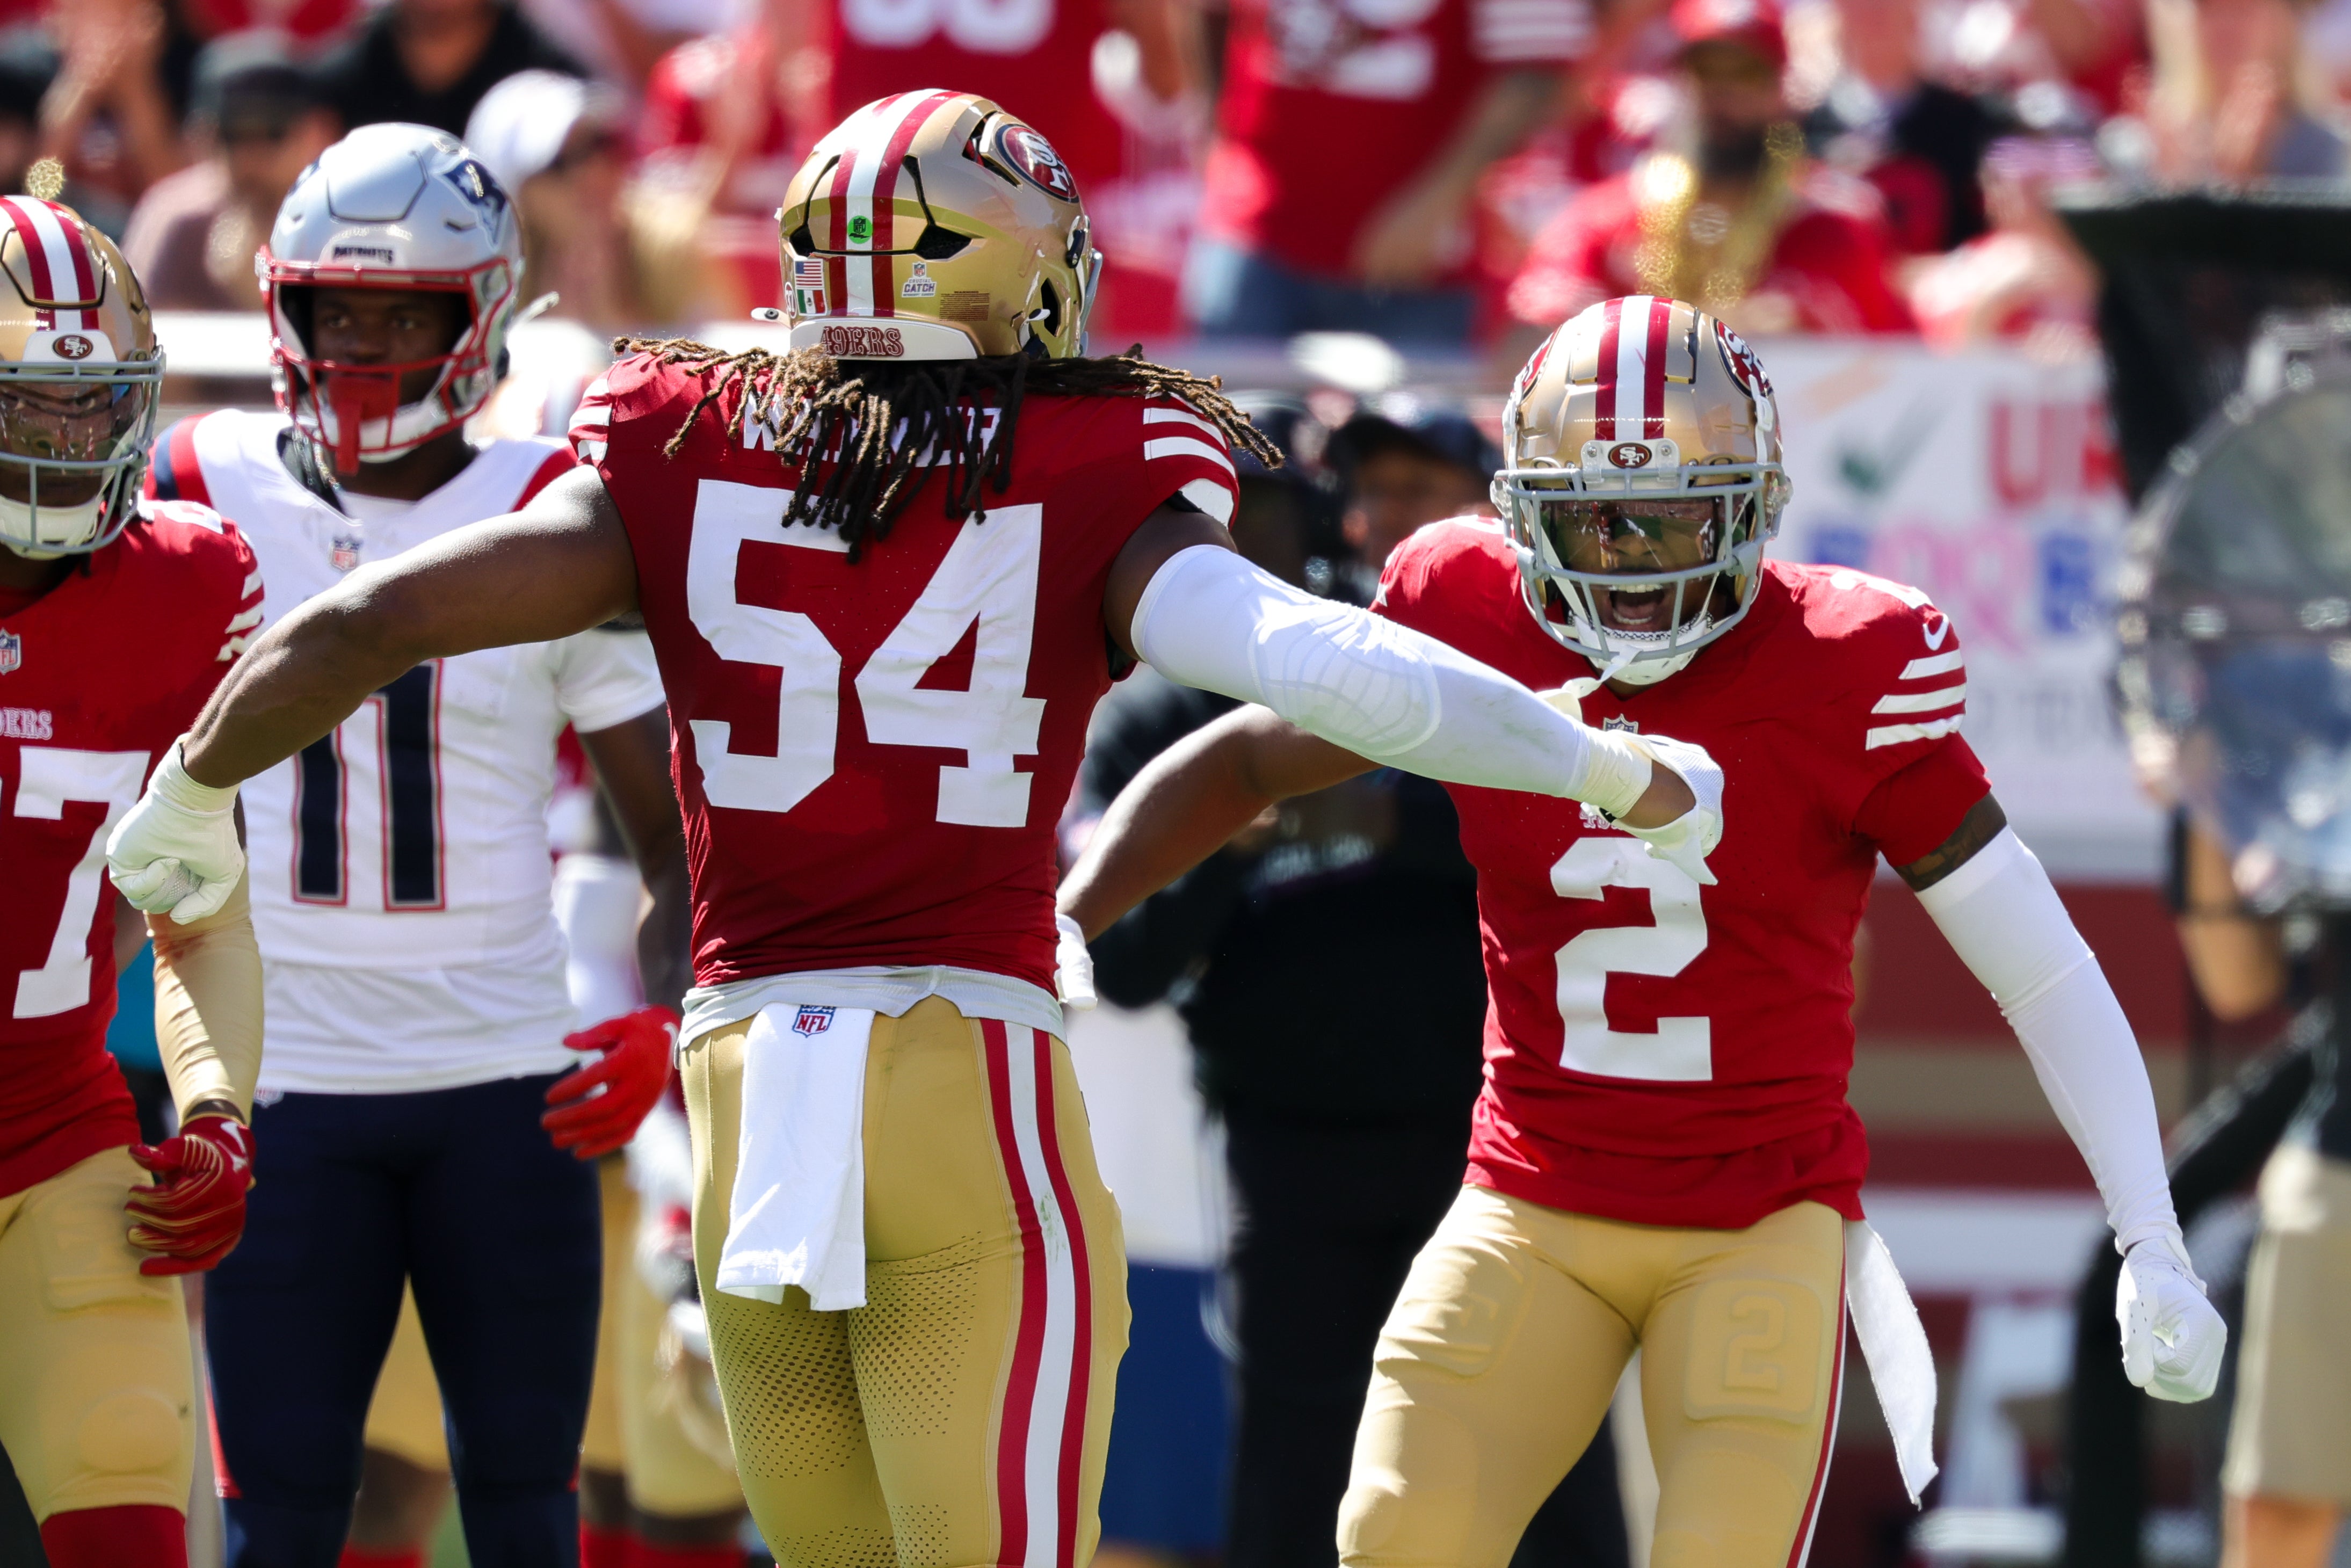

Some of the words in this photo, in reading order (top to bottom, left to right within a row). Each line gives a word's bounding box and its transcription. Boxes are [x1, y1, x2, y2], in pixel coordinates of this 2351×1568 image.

[904, 284, 935, 293] CATCH
[821, 325, 904, 357] 49ERS
[1619, 446, 1645, 467] SF
[0, 649, 16, 665] FL
[687, 478, 1048, 828] 54
[0, 707, 53, 741] ERS
[292, 658, 445, 913] 11
[0, 745, 151, 1019] 7
[1550, 837, 1713, 1081] 2
[795, 1014, 827, 1033] NFL
[1722, 1293, 1784, 1392] 2
